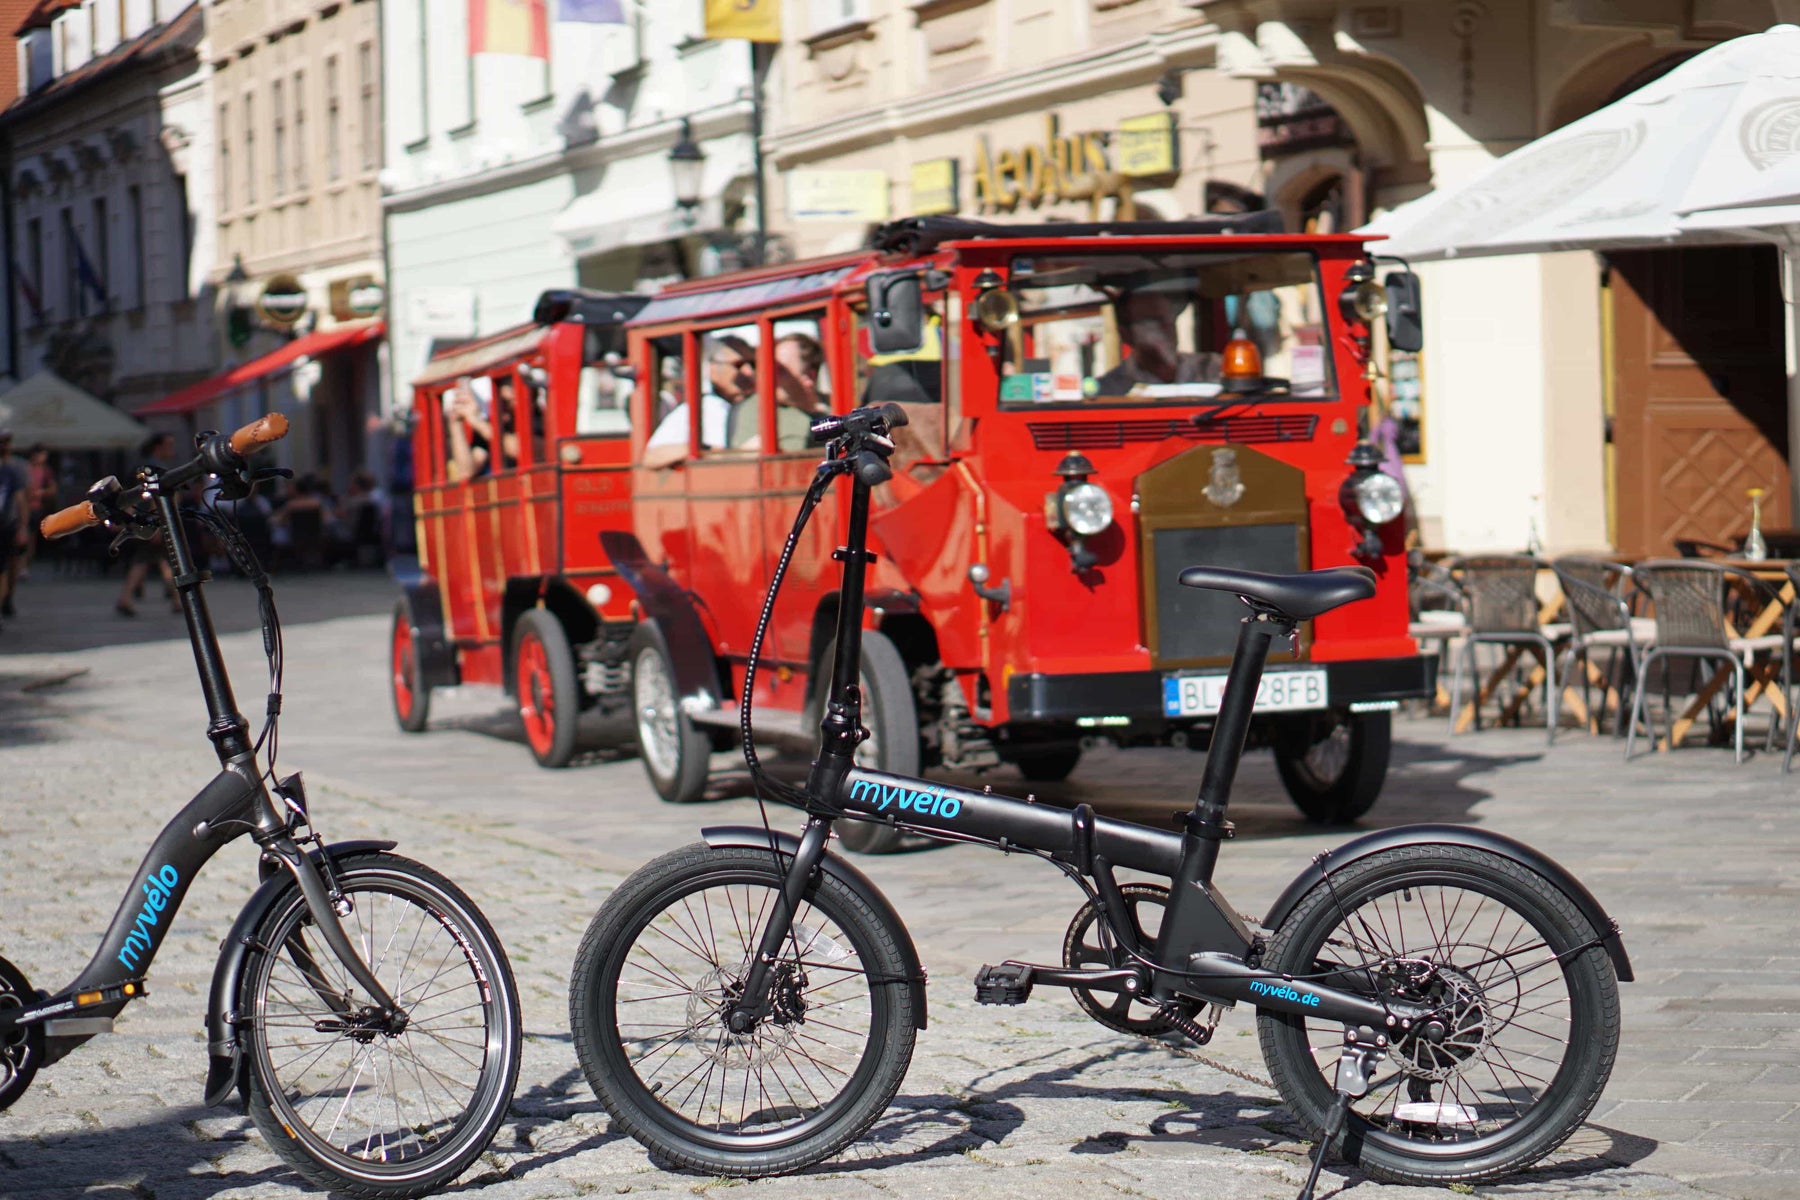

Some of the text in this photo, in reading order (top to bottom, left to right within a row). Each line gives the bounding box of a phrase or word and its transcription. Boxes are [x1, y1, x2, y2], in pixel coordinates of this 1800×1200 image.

[973, 112, 1110, 206] Aeolus
[1185, 676, 1320, 710] BL 28FB
[850, 780, 961, 818] myvélo
[118, 864, 178, 971] myvélo
[1249, 981, 1320, 1007] myvélo.de
